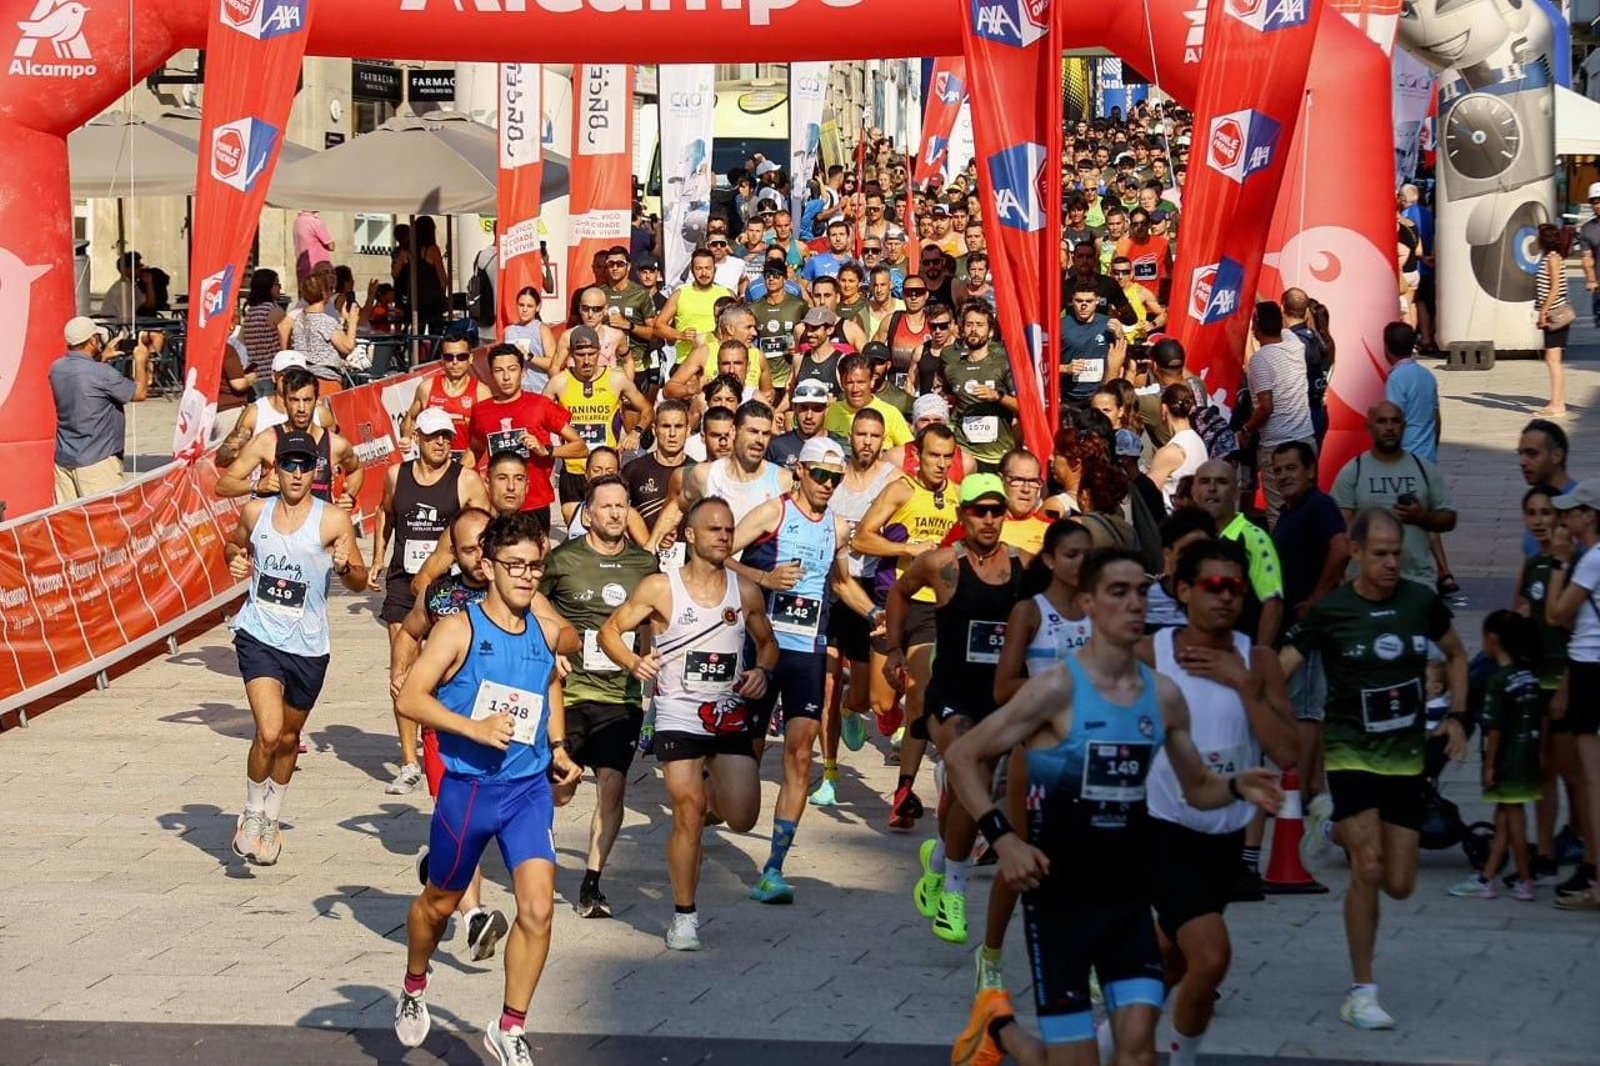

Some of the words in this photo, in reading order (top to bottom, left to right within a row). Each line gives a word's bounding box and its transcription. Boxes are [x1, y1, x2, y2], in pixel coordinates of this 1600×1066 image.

[260, 5, 300, 32] AXA
[8, 59, 97, 79] Alcampo
[1369, 476, 1417, 494] LIVE
[412, 550, 431, 559] 12
[266, 587, 292, 599] 419
[785, 606, 809, 618] 142
[699, 663, 725, 674] 352
[488, 700, 529, 719] 1348
[1389, 699, 1401, 711] 2
[1106, 759, 1140, 776] 149
